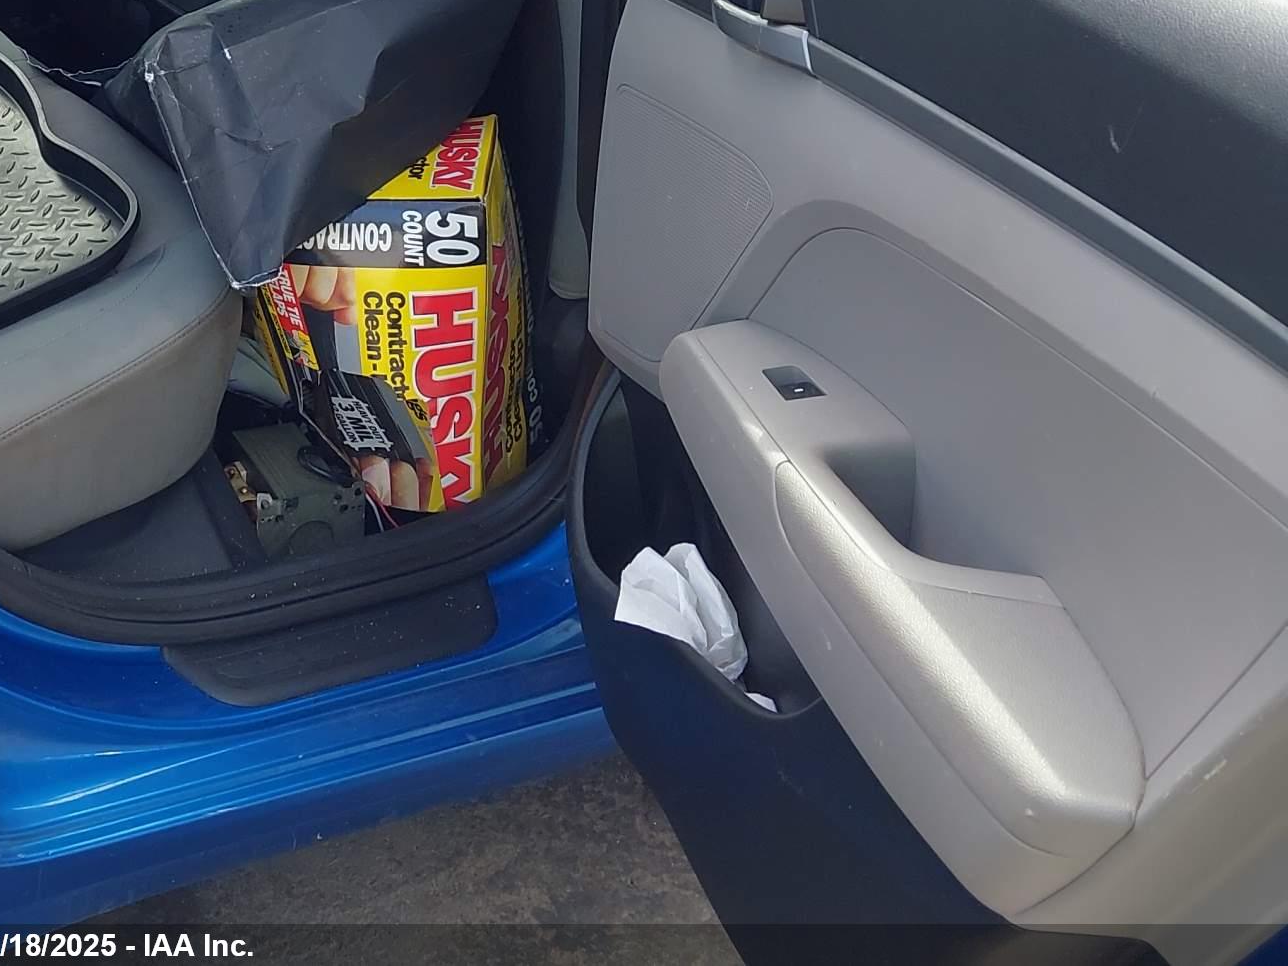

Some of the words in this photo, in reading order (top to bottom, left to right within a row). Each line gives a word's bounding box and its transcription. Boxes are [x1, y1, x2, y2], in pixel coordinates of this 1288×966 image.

[432, 120, 484, 191] HUSKY
[296, 222, 392, 252] CONTRA
[402, 210, 425, 266] COUNT
[425, 210, 480, 265] 50
[280, 269, 296, 304] TRUE
[287, 300, 304, 331] TIE
[338, 402, 355, 413] 3
[345, 415, 375, 442] MIL
